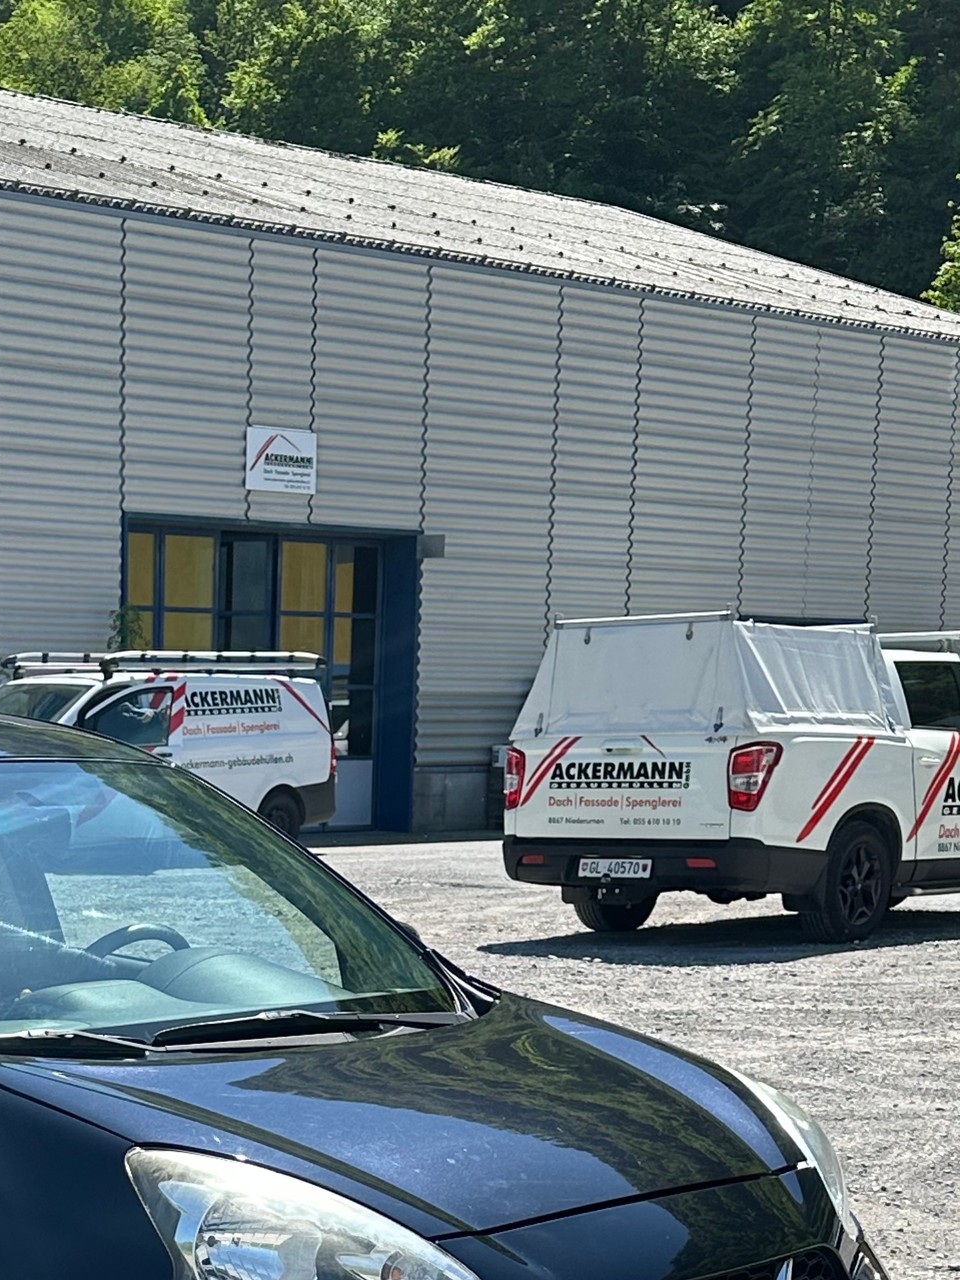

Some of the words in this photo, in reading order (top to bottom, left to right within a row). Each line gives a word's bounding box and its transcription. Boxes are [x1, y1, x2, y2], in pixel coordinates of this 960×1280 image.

[265, 453, 310, 465] ACKERMANN
[182, 723, 202, 736] Dach
[206, 723, 237, 734] Fassade
[241, 721, 279, 734] Spenglerei
[551, 762, 684, 780] ACKERMANN
[944, 777, 960, 803] A
[548, 796, 573, 807] Dach
[579, 796, 620, 807] Fassade
[625, 797, 682, 810] Spenglerei
[589, 861, 602, 874] GL
[606, 861, 640, 875] 40570
